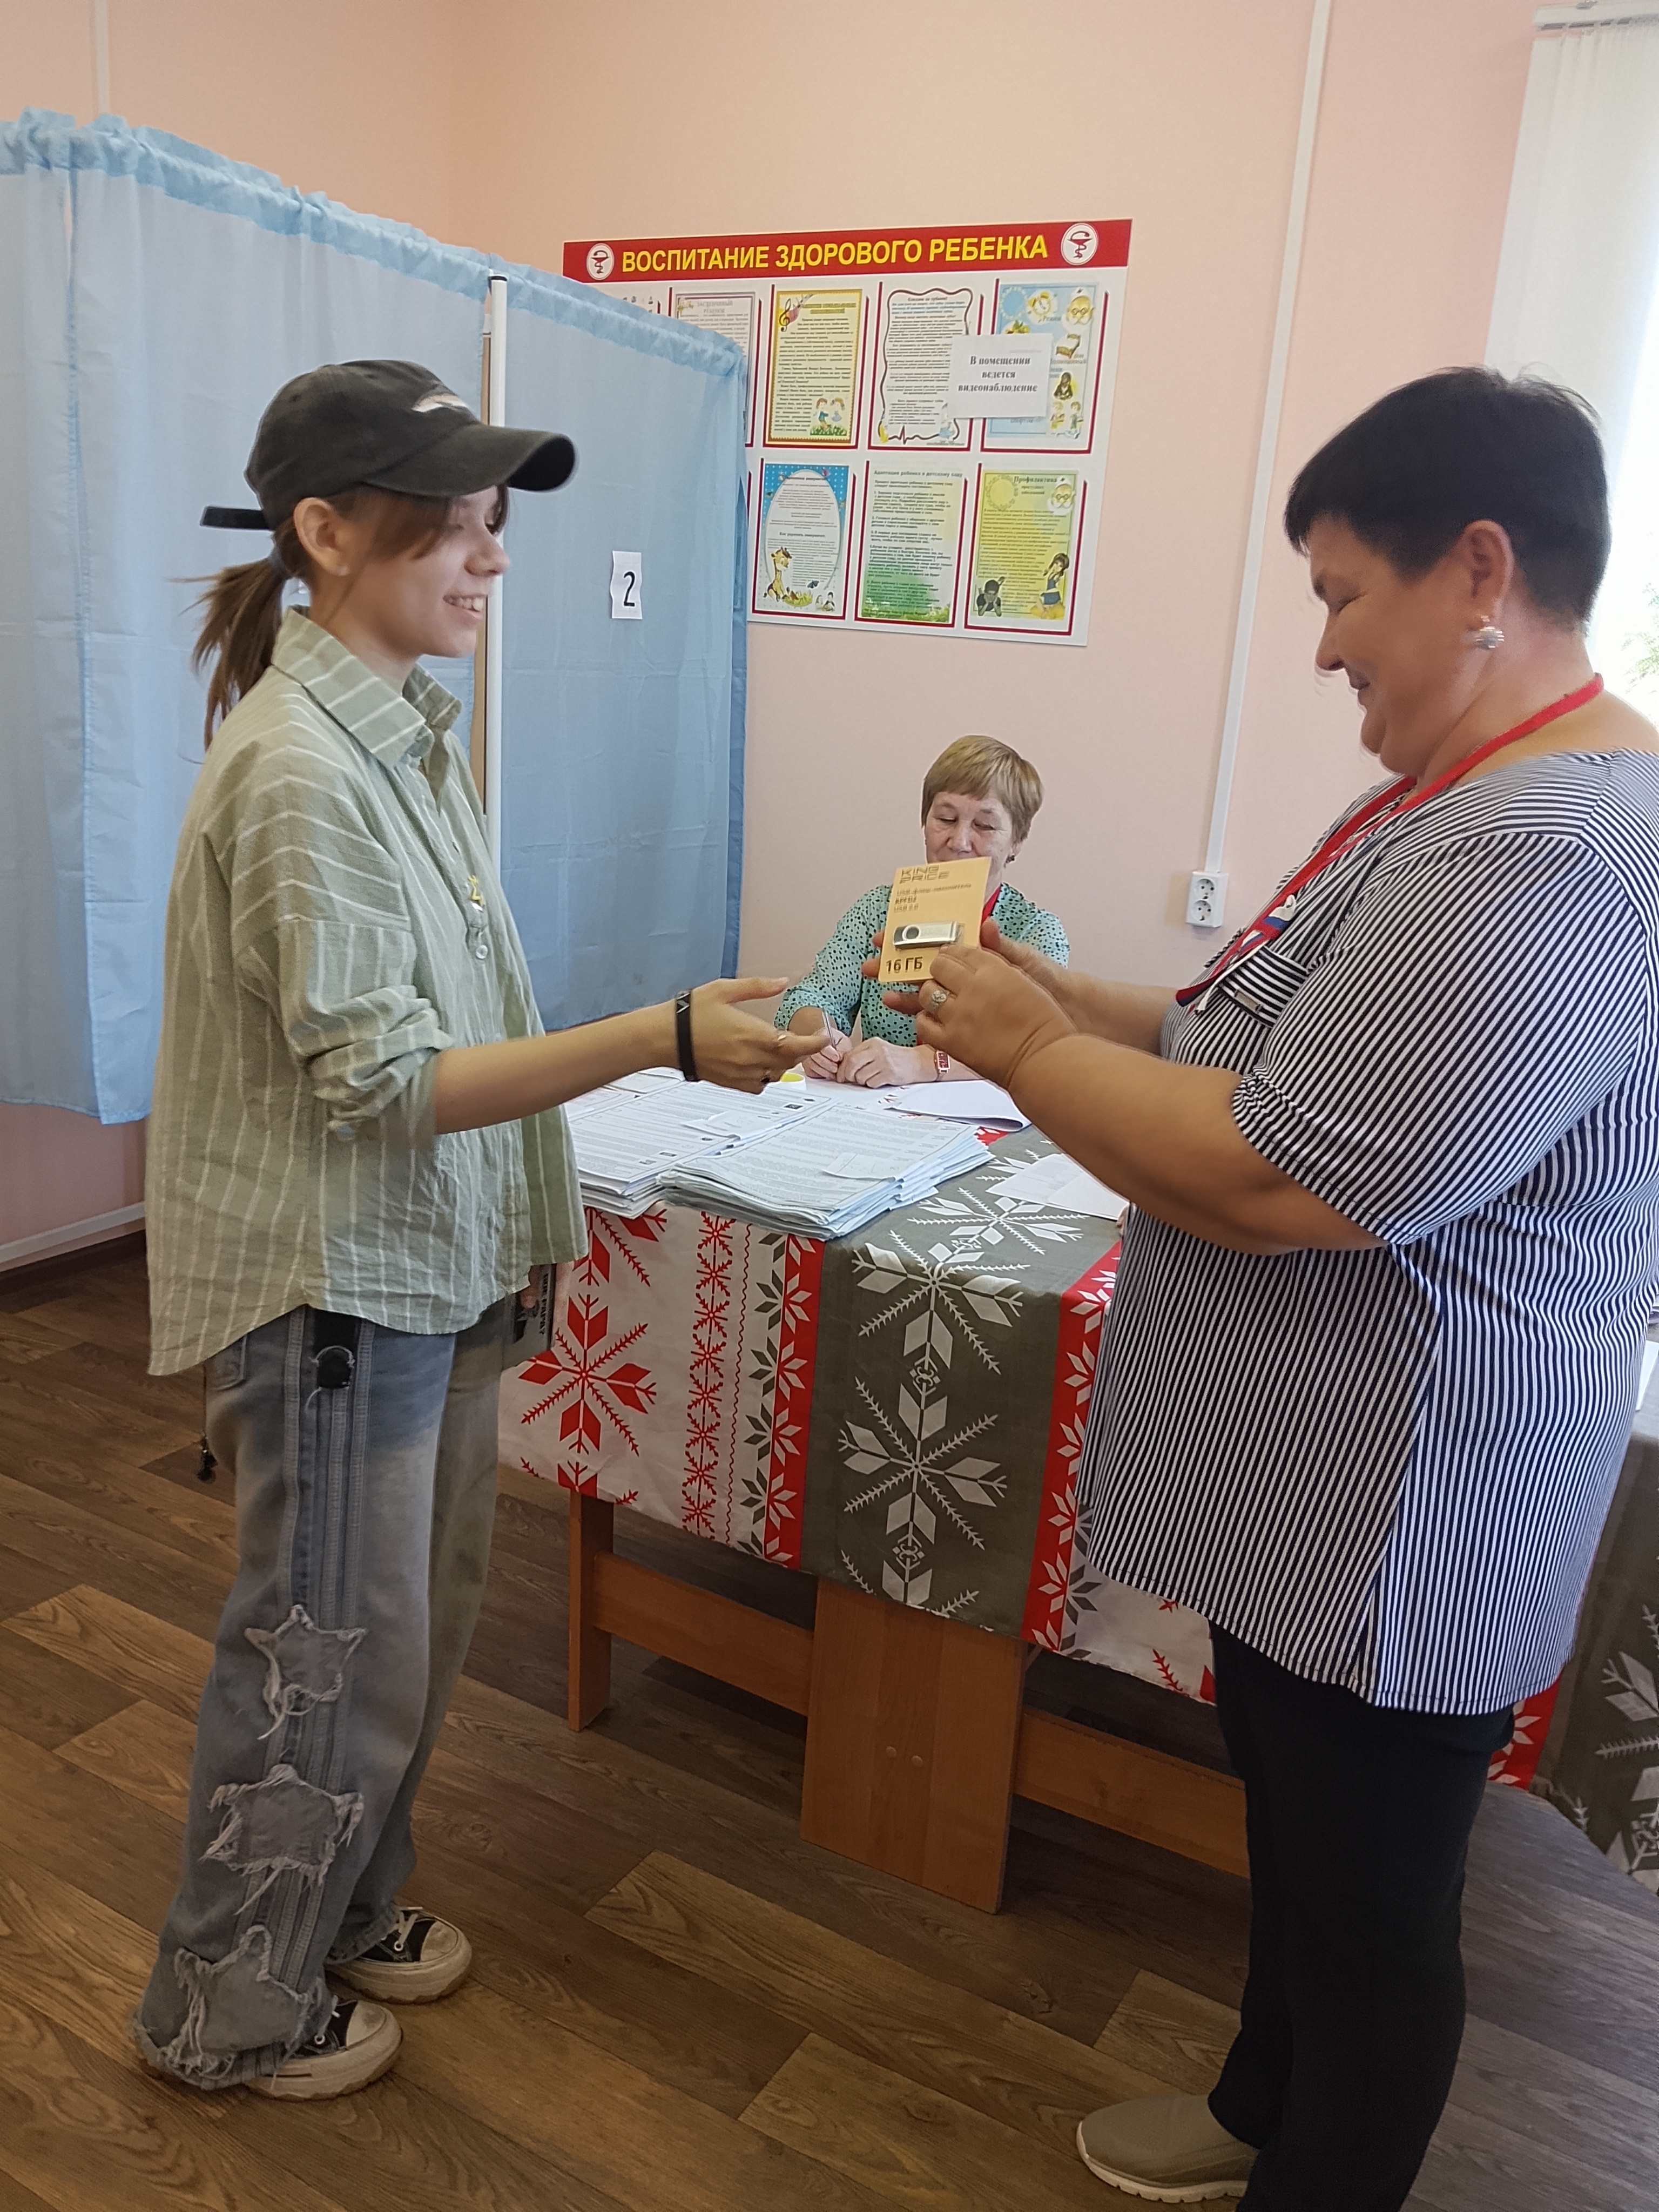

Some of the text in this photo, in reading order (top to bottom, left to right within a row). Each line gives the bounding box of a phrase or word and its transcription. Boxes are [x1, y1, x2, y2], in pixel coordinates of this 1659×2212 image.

[622, 234, 1049, 272] ВОСПИТАНИЕ ЗДОРОВОГО РЕБЕНКА
[970, 355, 1031, 366] В помещении
[982, 370, 1016, 379] ведется
[957, 383, 1038, 393] видеонаблюдение
[624, 571, 635, 607] 2
[901, 865, 940, 877] KING
[899, 871, 949, 884] PRICE
[886, 956, 923, 974] 16 ГБ
